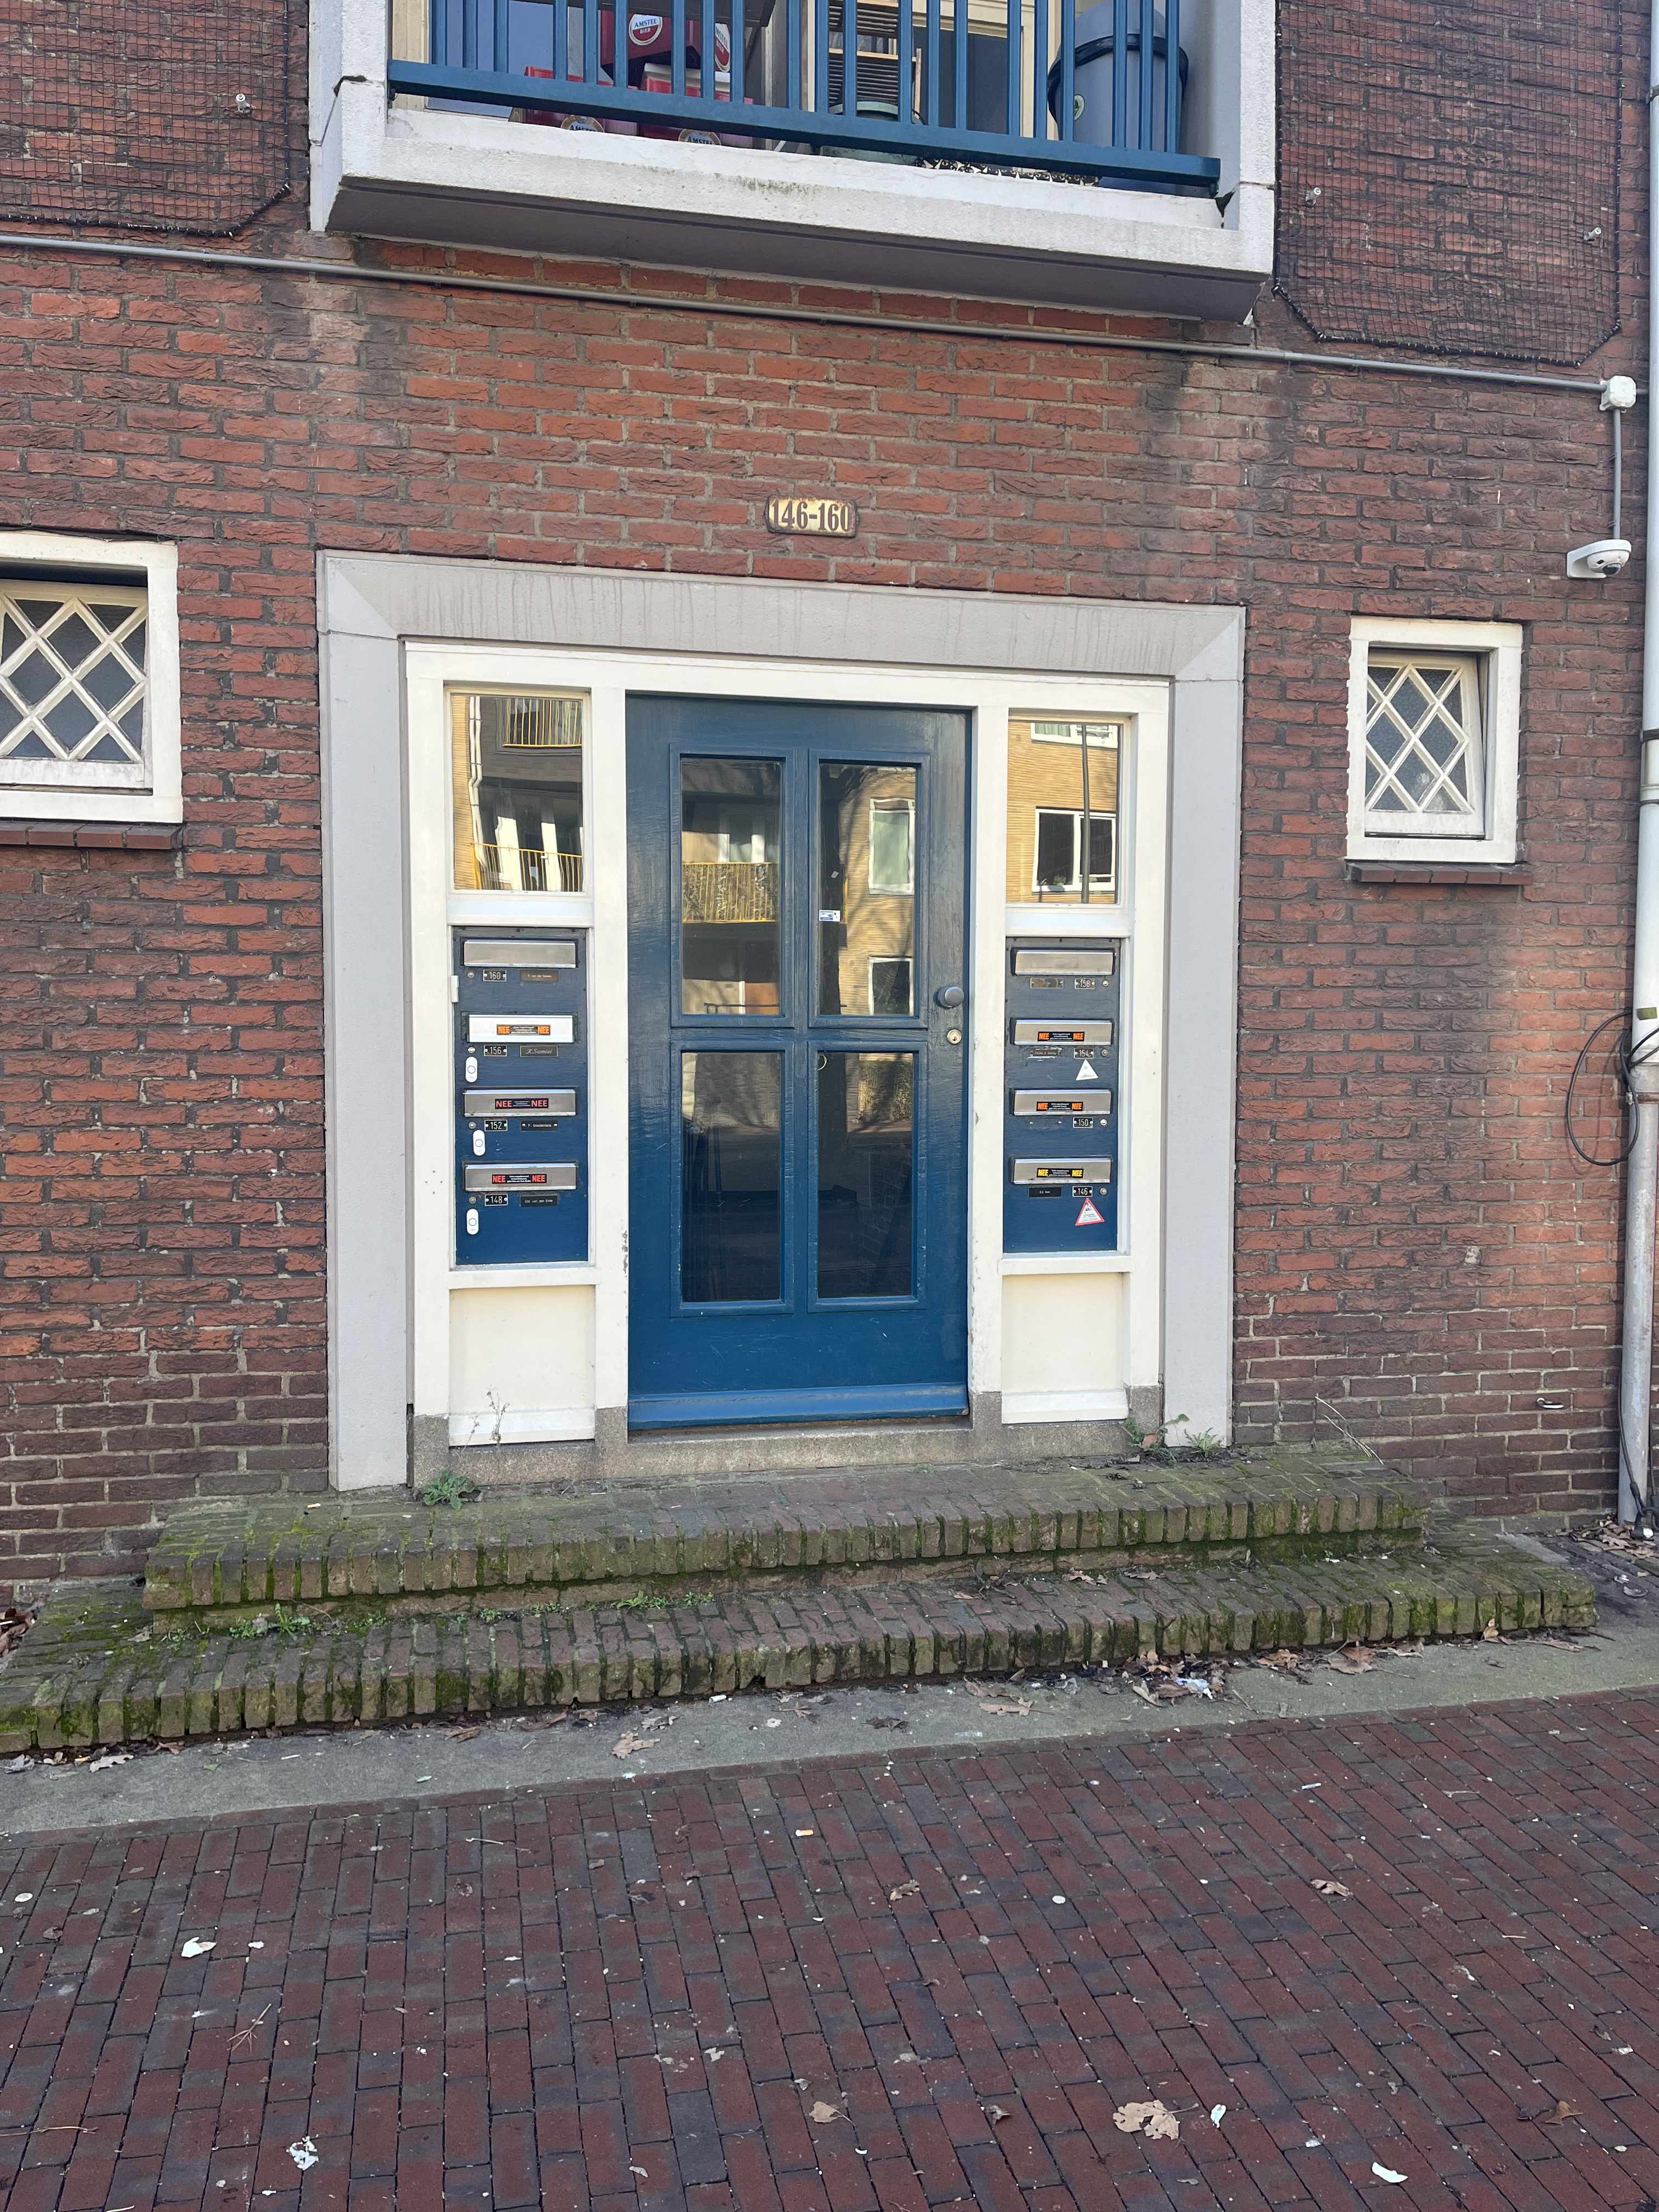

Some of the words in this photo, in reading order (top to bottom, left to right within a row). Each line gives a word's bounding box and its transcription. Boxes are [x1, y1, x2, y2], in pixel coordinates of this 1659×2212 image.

[634, 18, 658, 28] AMSTEL
[715, 26, 729, 49] MSTEL
[772, 500, 851, 532] 146-160
[489, 971, 501, 980] 160
[1080, 979, 1091, 988] 158
[490, 1046, 501, 1054] 156
[490, 1121, 502, 1130] 152
